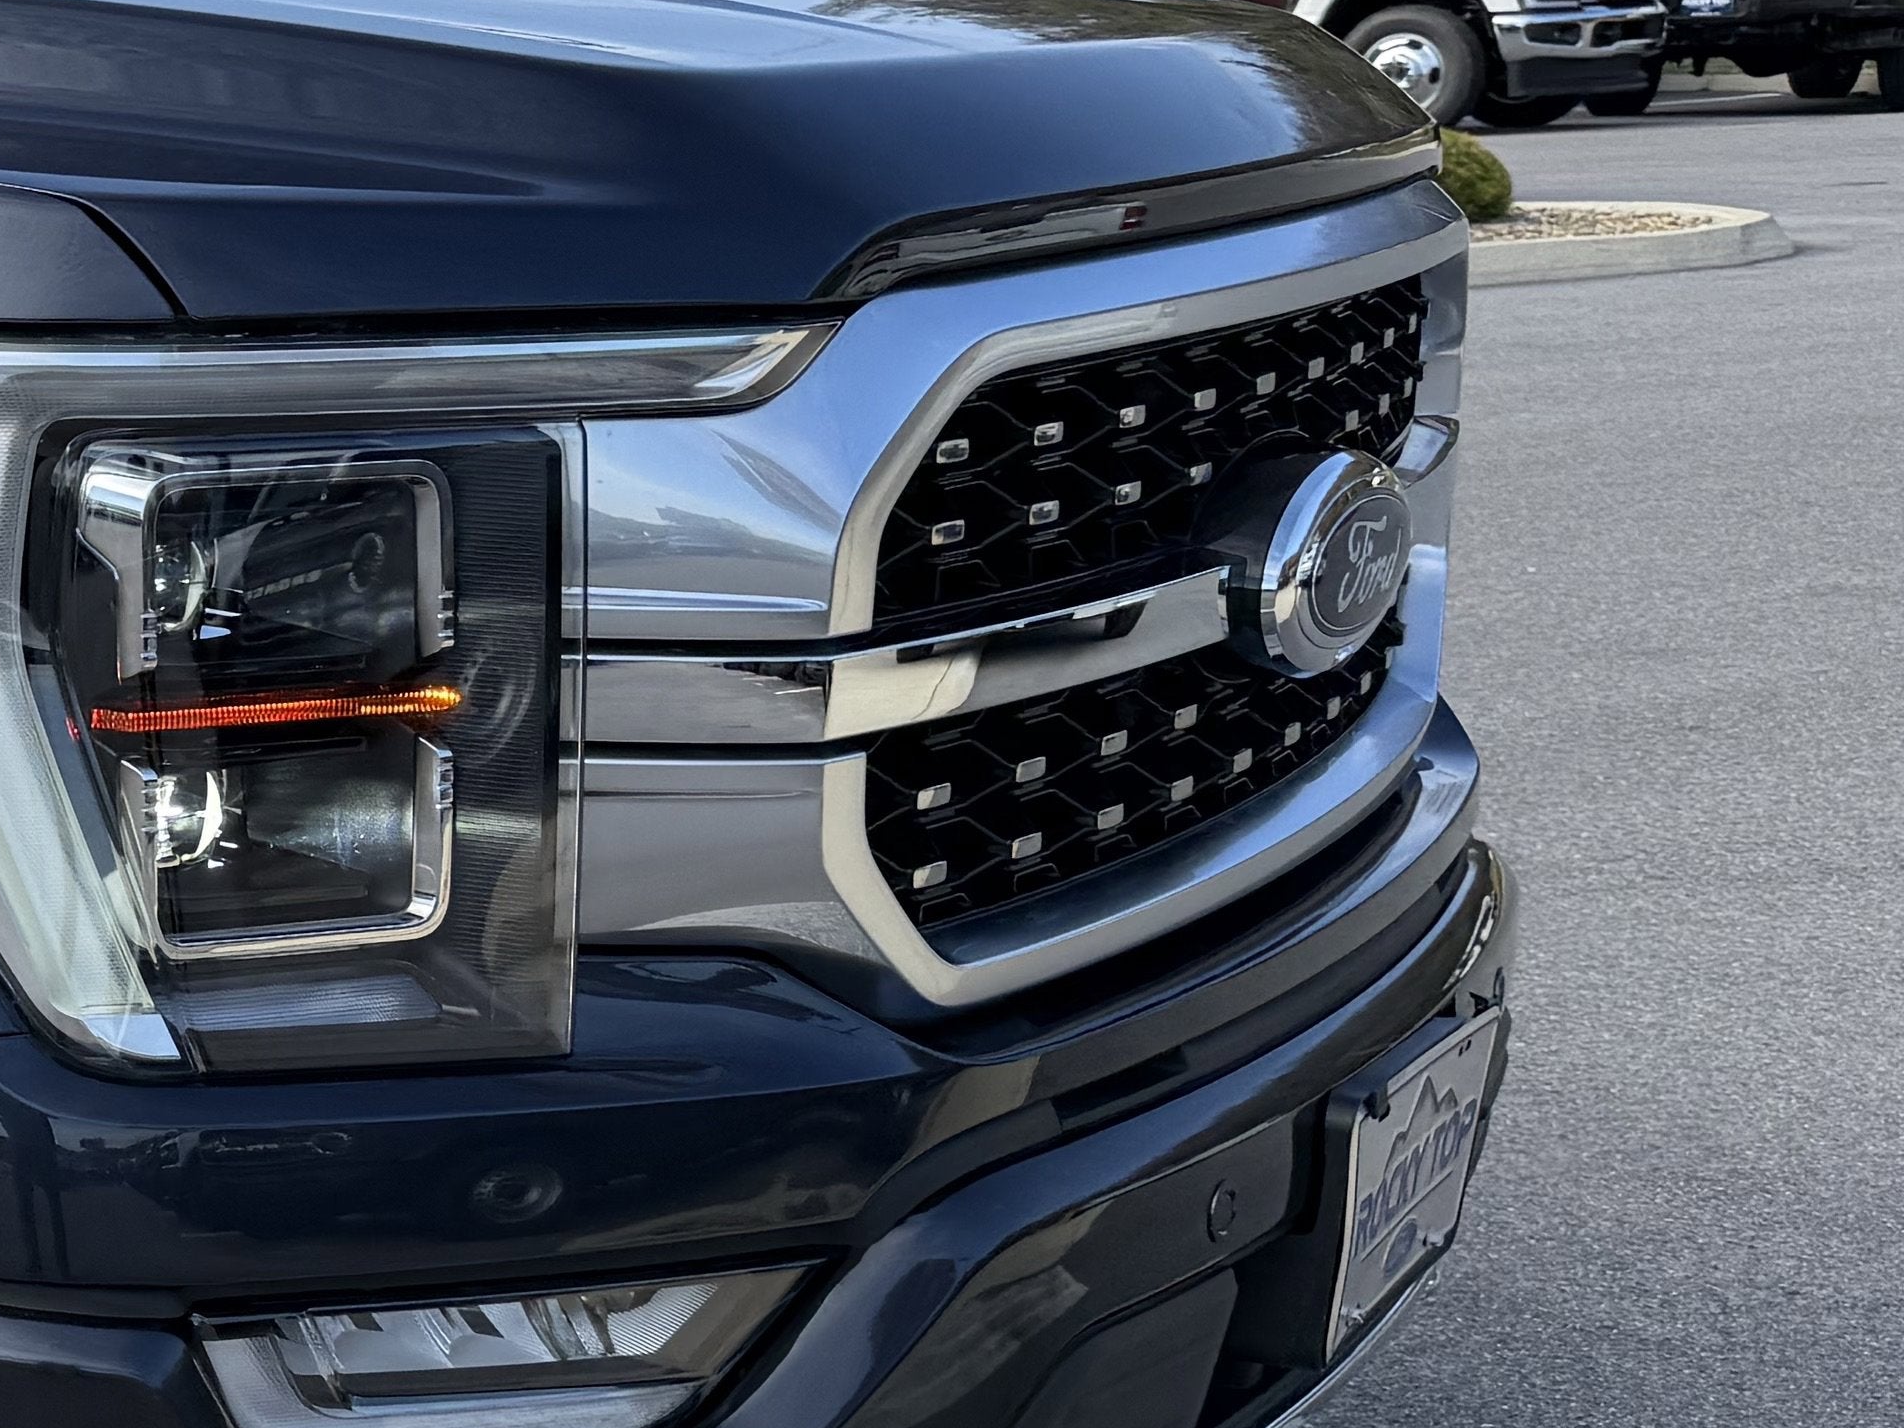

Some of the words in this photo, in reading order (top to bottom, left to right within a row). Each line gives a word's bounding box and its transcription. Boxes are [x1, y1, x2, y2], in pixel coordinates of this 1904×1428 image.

[1337, 514, 1403, 614] Ford
[1354, 1133, 1430, 1259] ROCKY
[1430, 1097, 1478, 1180] TOP
